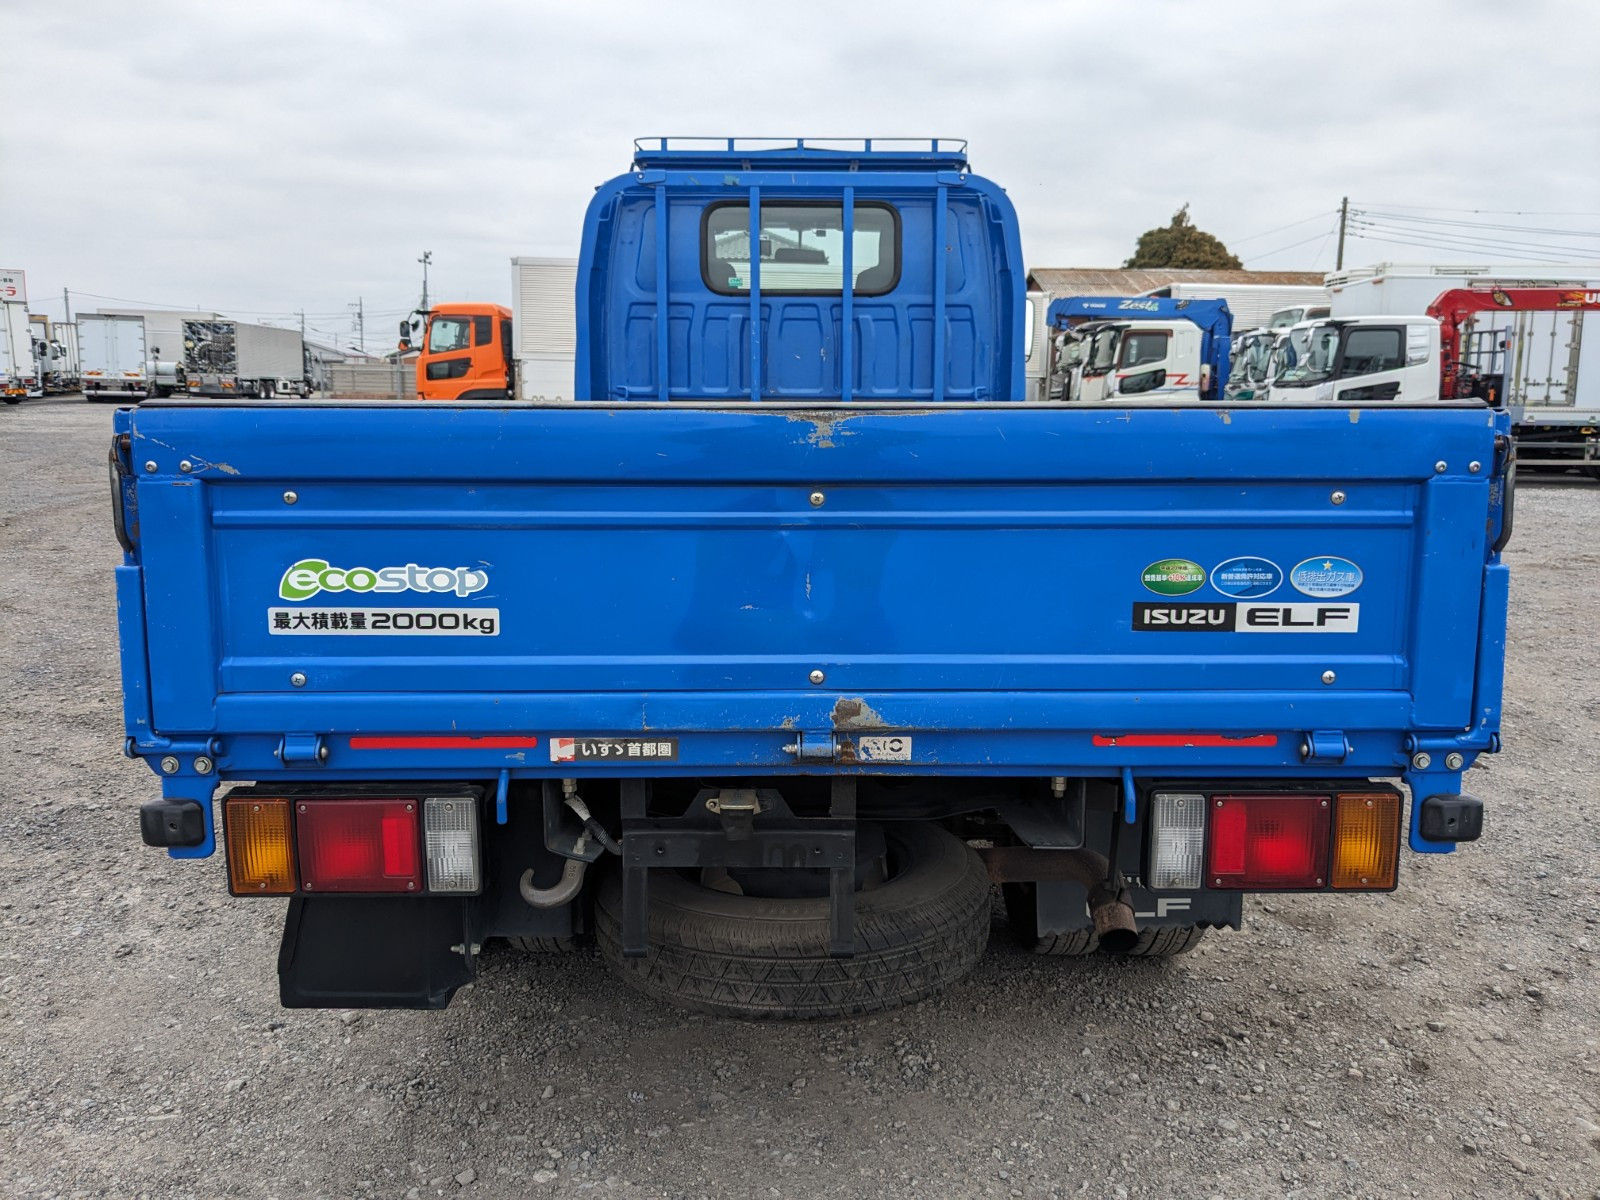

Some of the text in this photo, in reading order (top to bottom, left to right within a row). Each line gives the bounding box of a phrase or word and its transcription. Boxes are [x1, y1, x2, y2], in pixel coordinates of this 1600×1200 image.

[283, 562, 488, 597] ecostop
[1297, 570, 1356, 582] 低排出ガス車
[1143, 607, 1351, 627] ISUZU ELF
